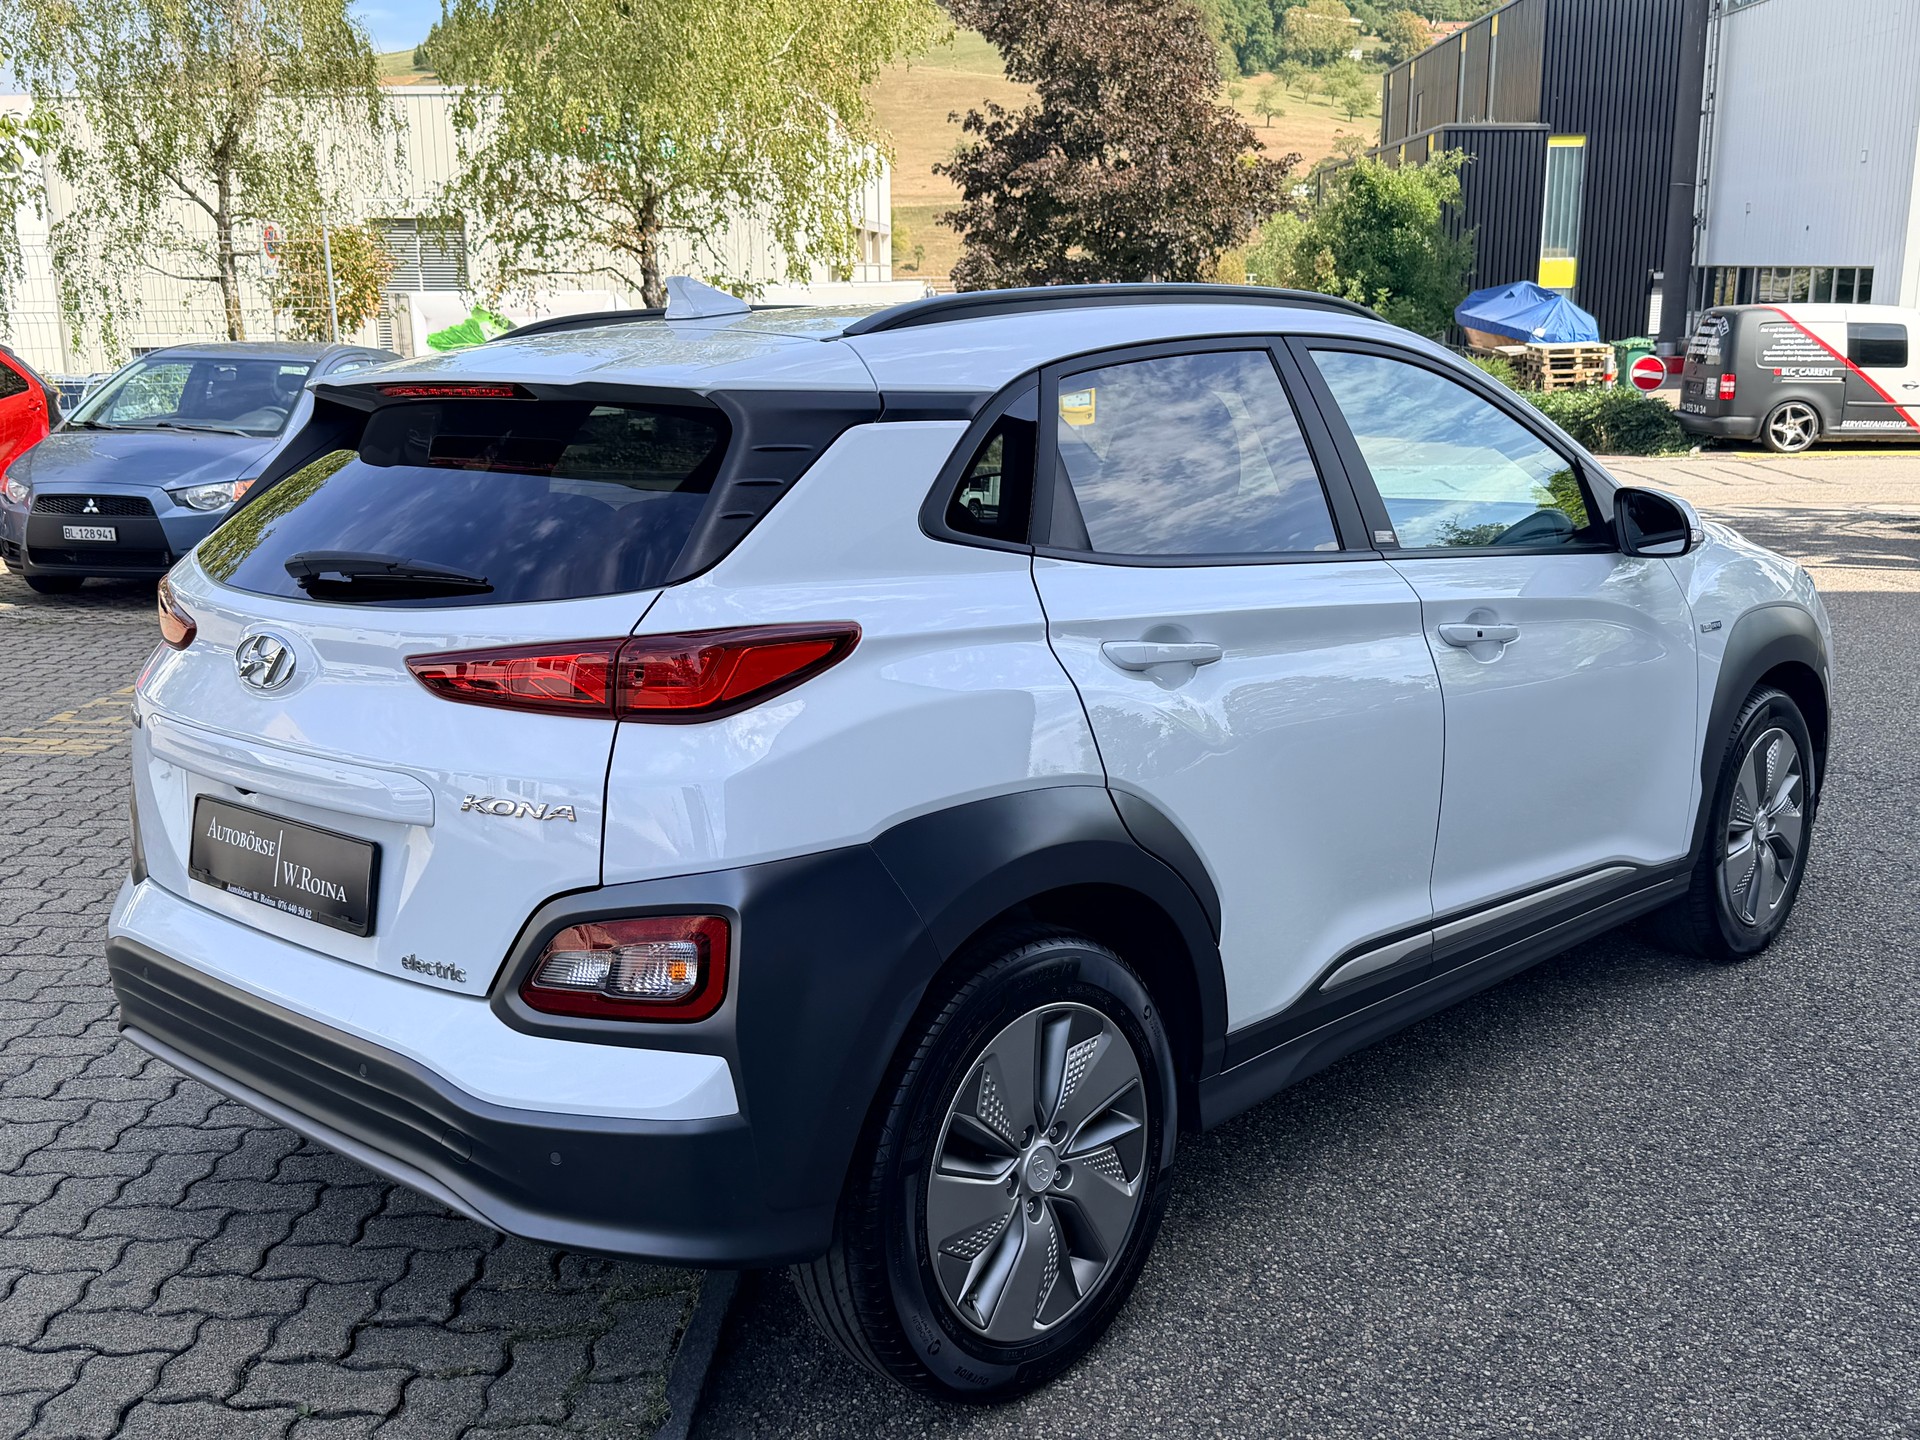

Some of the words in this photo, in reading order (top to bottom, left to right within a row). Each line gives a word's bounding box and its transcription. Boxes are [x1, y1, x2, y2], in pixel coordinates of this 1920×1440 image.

[79, 528, 114, 540] 128941
[460, 793, 578, 823] KONA
[277, 899, 288, 911] 076
[288, 903, 297, 914] 440
[305, 908, 312, 919] 82
[401, 953, 467, 983] electric
